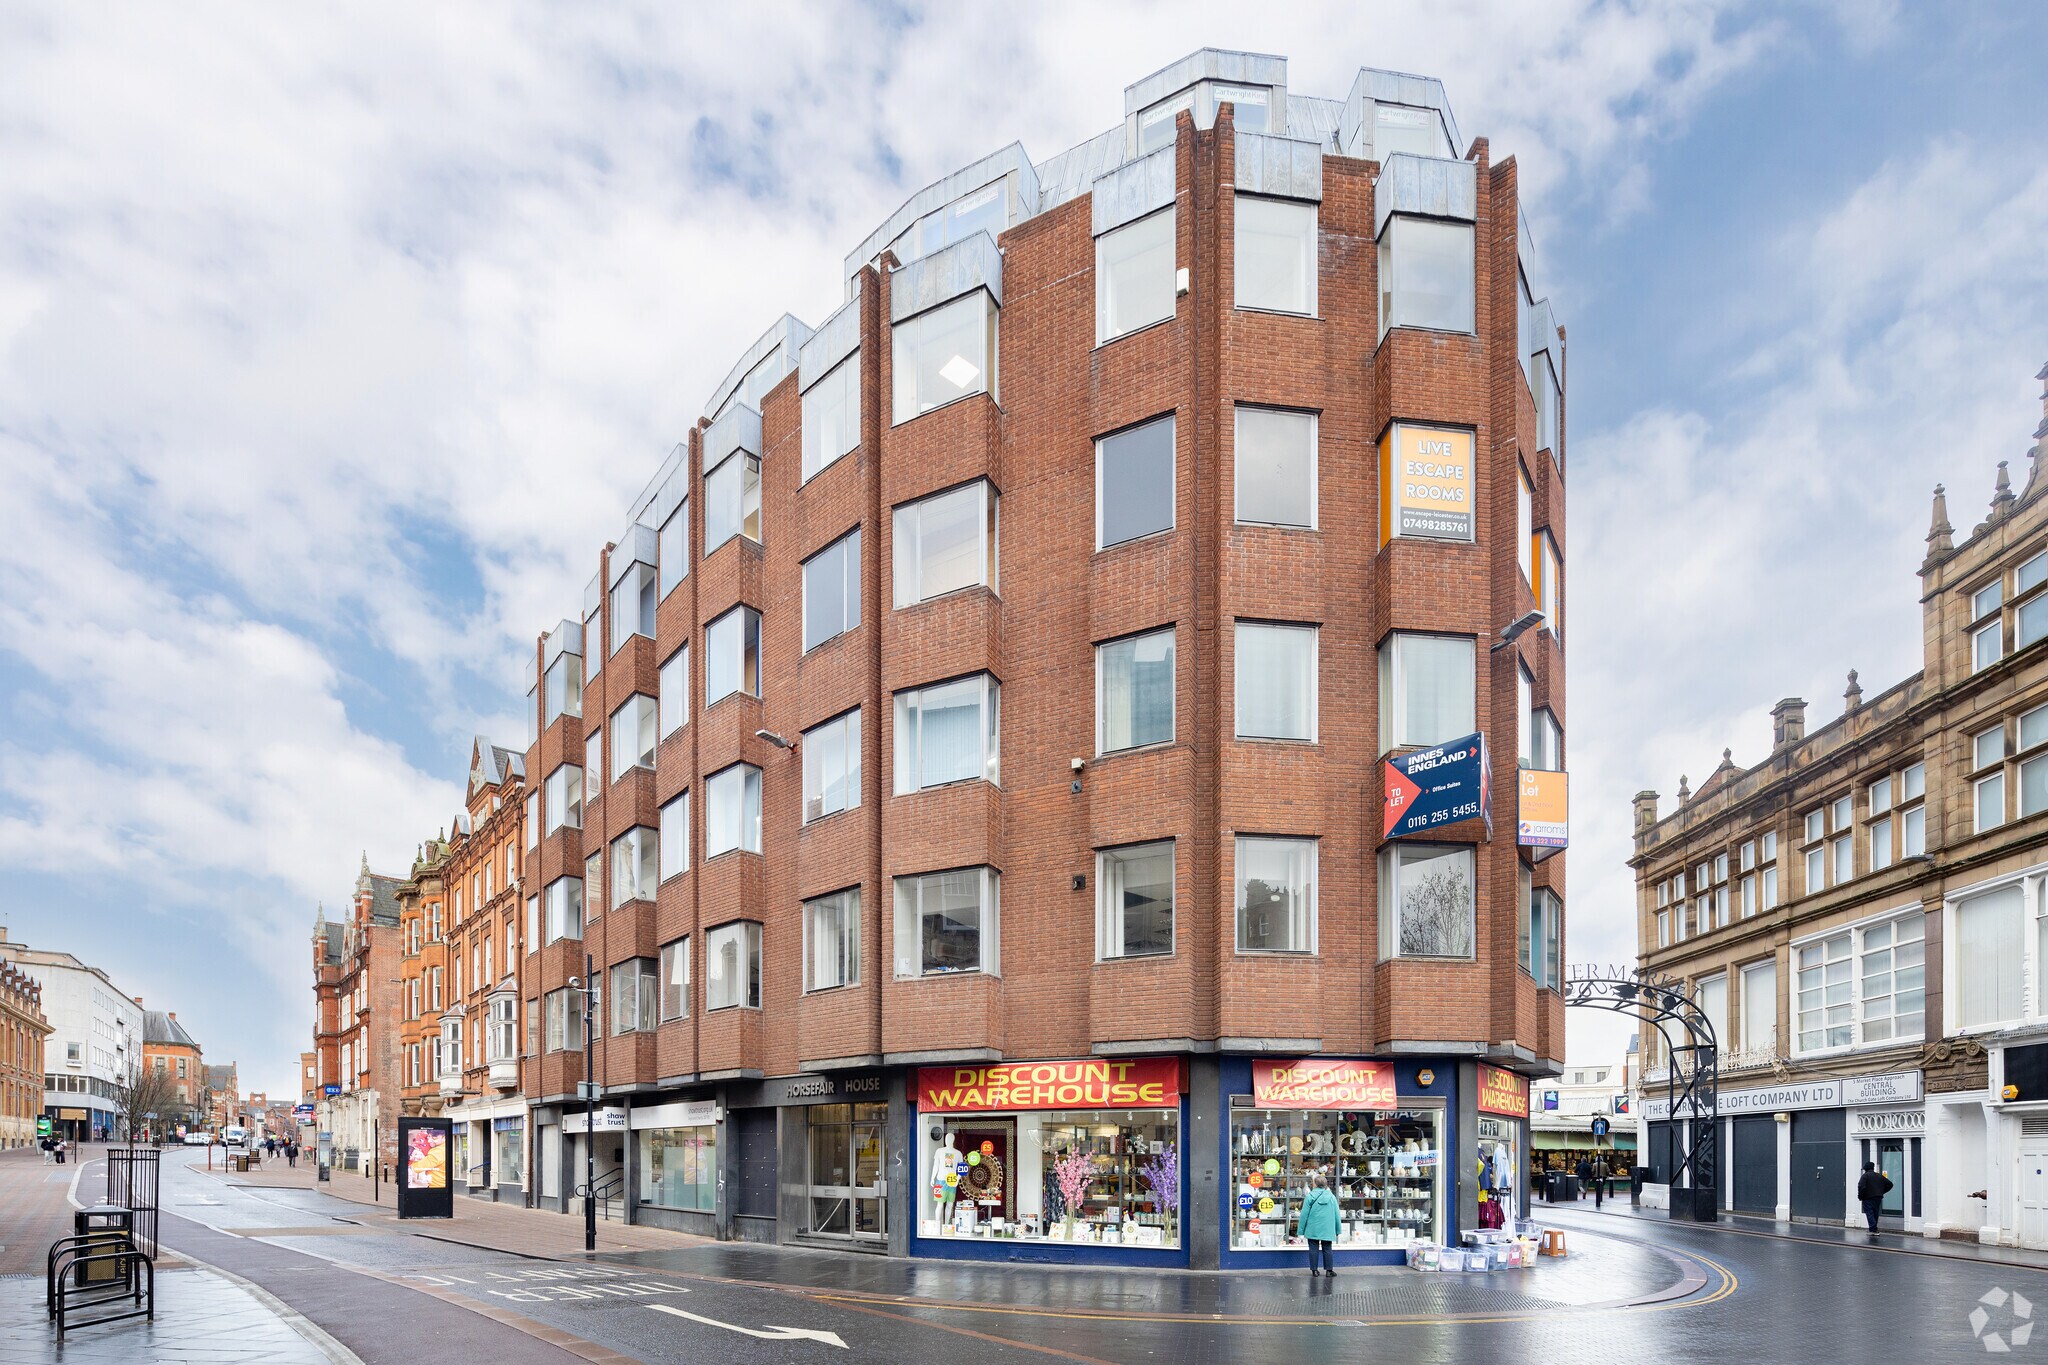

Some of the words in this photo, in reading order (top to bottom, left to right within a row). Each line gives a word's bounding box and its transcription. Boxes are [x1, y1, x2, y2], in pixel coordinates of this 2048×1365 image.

[1418, 440, 1451, 456] LIVE
[1406, 461, 1463, 480] ESCAPE
[1406, 483, 1464, 502] ROOMS
[1403, 518, 1468, 532] 07498285761
[1408, 748, 1444, 766] INNES
[1408, 751, 1466, 775] ENGLAND
[1447, 781, 1460, 789] Suites
[1521, 771, 1534, 783] To
[1391, 787, 1401, 797] TO
[1522, 784, 1539, 797] Let
[1390, 796, 1404, 807] LET
[1408, 815, 1427, 828] 0116
[1431, 809, 1448, 823] 255
[1452, 802, 1477, 817] 5455
[1533, 825, 1565, 834] jarroms
[1608, 964, 1704, 1001] MARKET
[954, 1063, 1135, 1087] DISCOUNT
[1272, 1069, 1376, 1085] DISCOUNT
[1488, 1069, 1521, 1094] DISCOUNT
[787, 1081, 834, 1098] HORSEFAIR
[845, 1078, 880, 1092] HOUSE
[1860, 1088, 1896, 1097] BUILDINGS
[1863, 1080, 1893, 1091] CENTRAL
[929, 1083, 1163, 1107] WAREHOUSE
[1257, 1086, 1394, 1103] WAREHOUSE
[1482, 1088, 1525, 1113] WAREHOUSE
[1648, 1104, 1662, 1114] THE
[1726, 1095, 1749, 1108] LOFT
[1752, 1090, 1808, 1105] COMPANY
[1812, 1087, 1834, 1100] LTD
[1250, 1176, 1261, 1184] £5
[1239, 1197, 1253, 1205] £10
[1249, 1222, 1260, 1230] £2
[487, 1282, 692, 1302] OTHER
